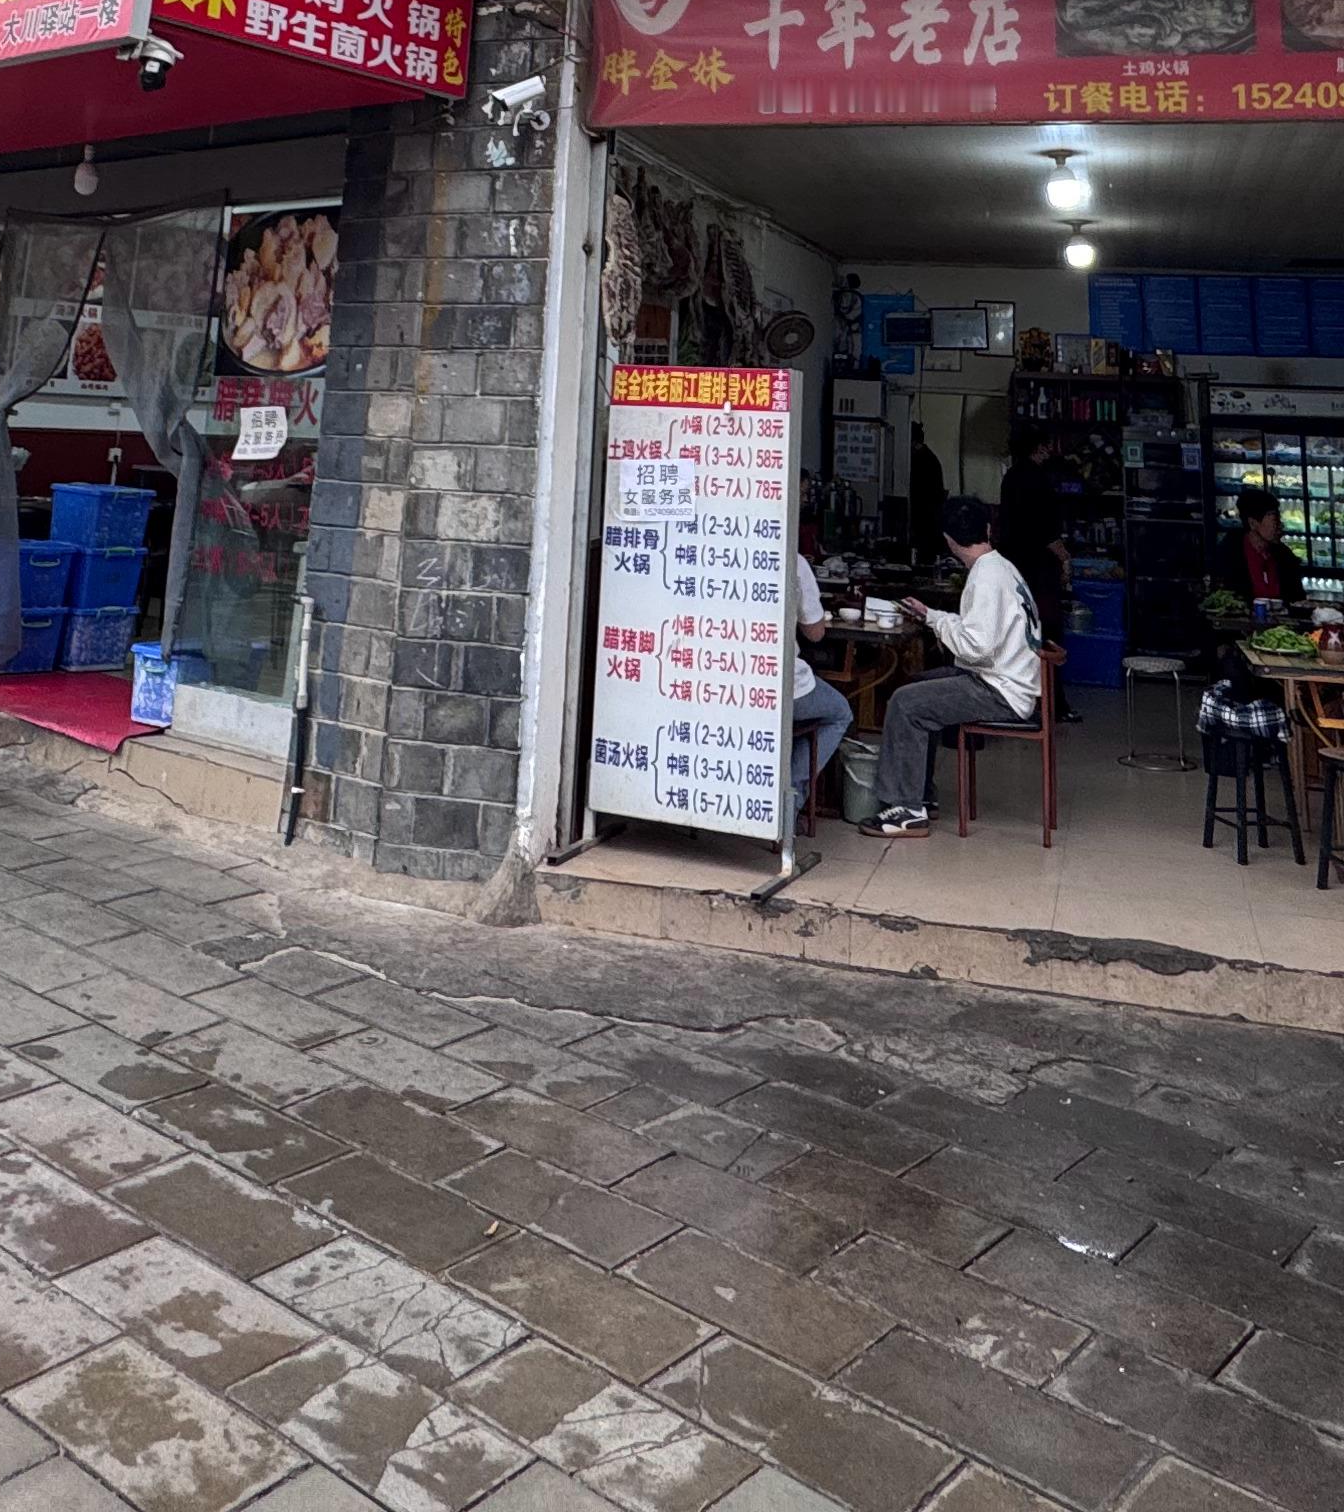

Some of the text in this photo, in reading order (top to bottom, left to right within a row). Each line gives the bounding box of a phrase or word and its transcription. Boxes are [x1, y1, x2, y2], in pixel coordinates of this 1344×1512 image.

[602, 48, 735, 96] 胖金妹
[1121, 59, 1191, 78] 土鸡火锅
[613, 369, 771, 407] 胖金妹老丽江腊排骨火锅
[636, 464, 679, 486] 招聘
[623, 488, 693, 505] 女服务员
[604, 525, 660, 551] 腊排骨
[614, 550, 651, 575] 火锅
[603, 625, 656, 655] 腊猪脚
[606, 655, 641, 683] 火锅
[594, 737, 649, 772] 菌汤火锅
